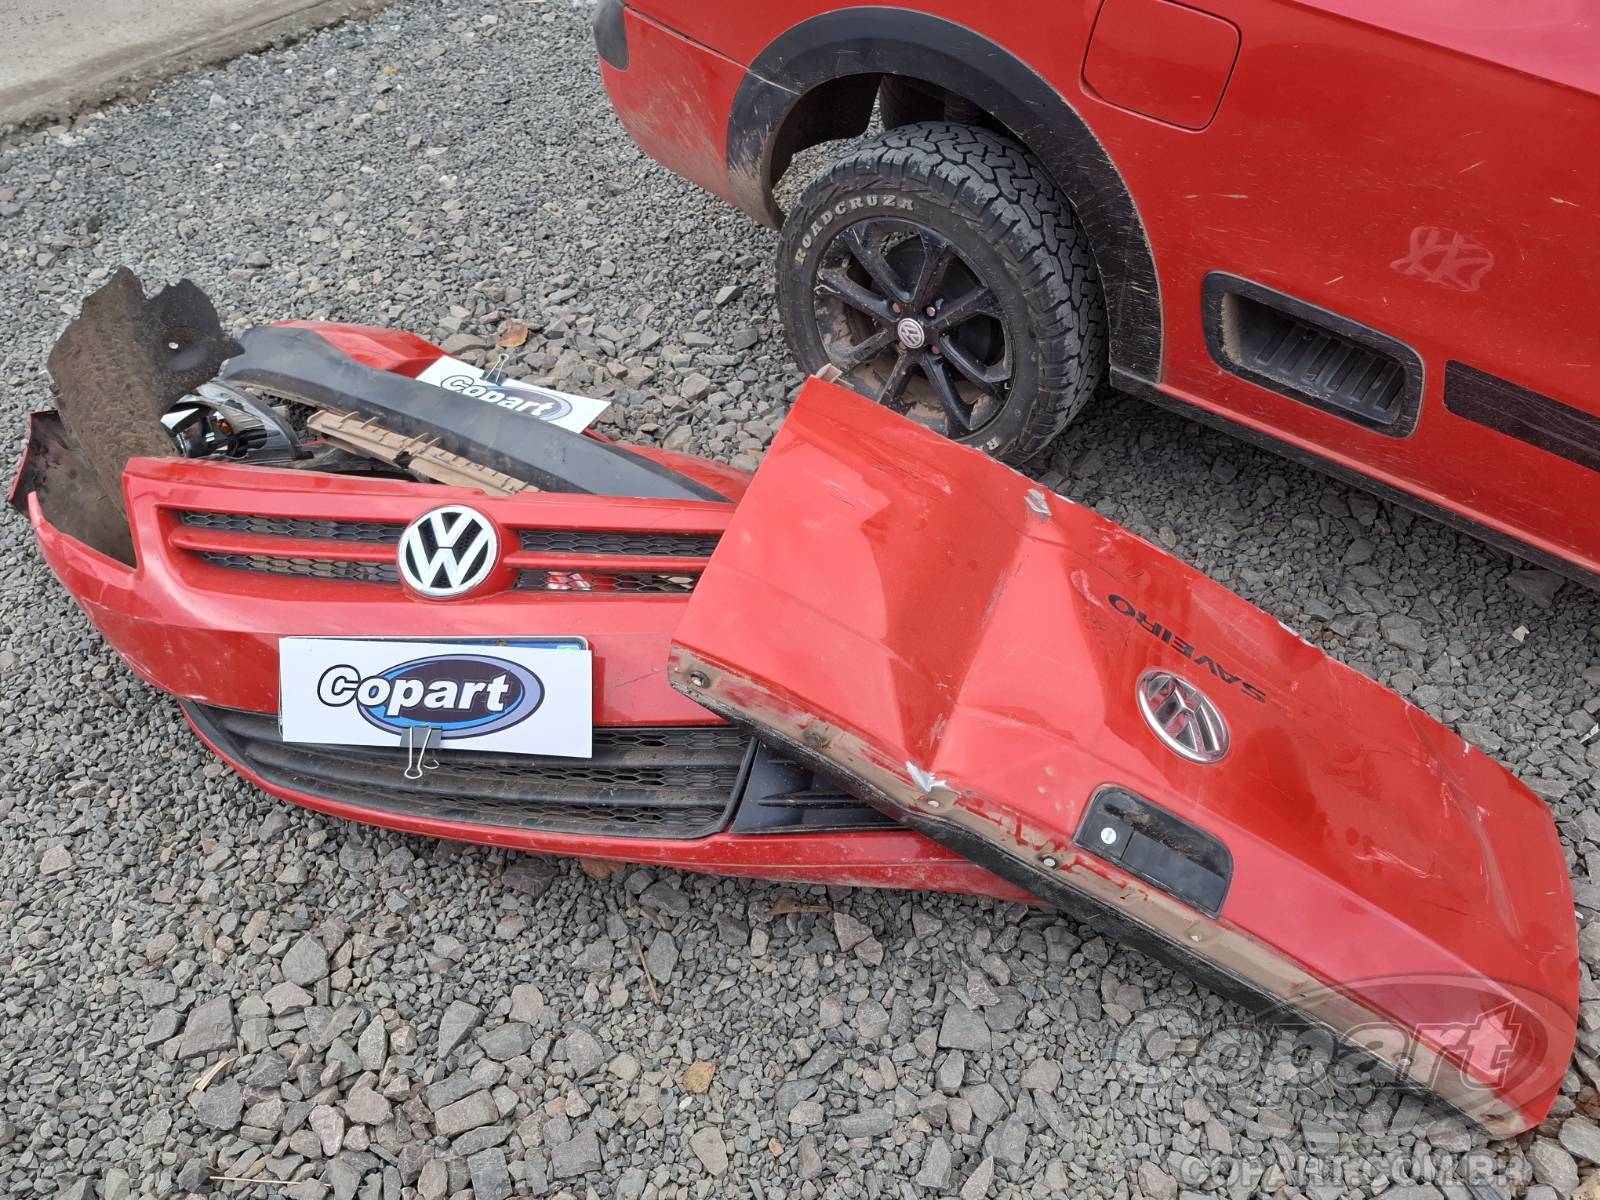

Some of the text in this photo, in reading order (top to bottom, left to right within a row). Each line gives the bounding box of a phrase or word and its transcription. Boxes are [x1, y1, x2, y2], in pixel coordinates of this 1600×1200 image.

[795, 194, 914, 264] ROADCRUZA
[440, 374, 556, 417] Copart
[1108, 594, 1266, 703] SAVEIRO
[317, 664, 511, 719] Copart
